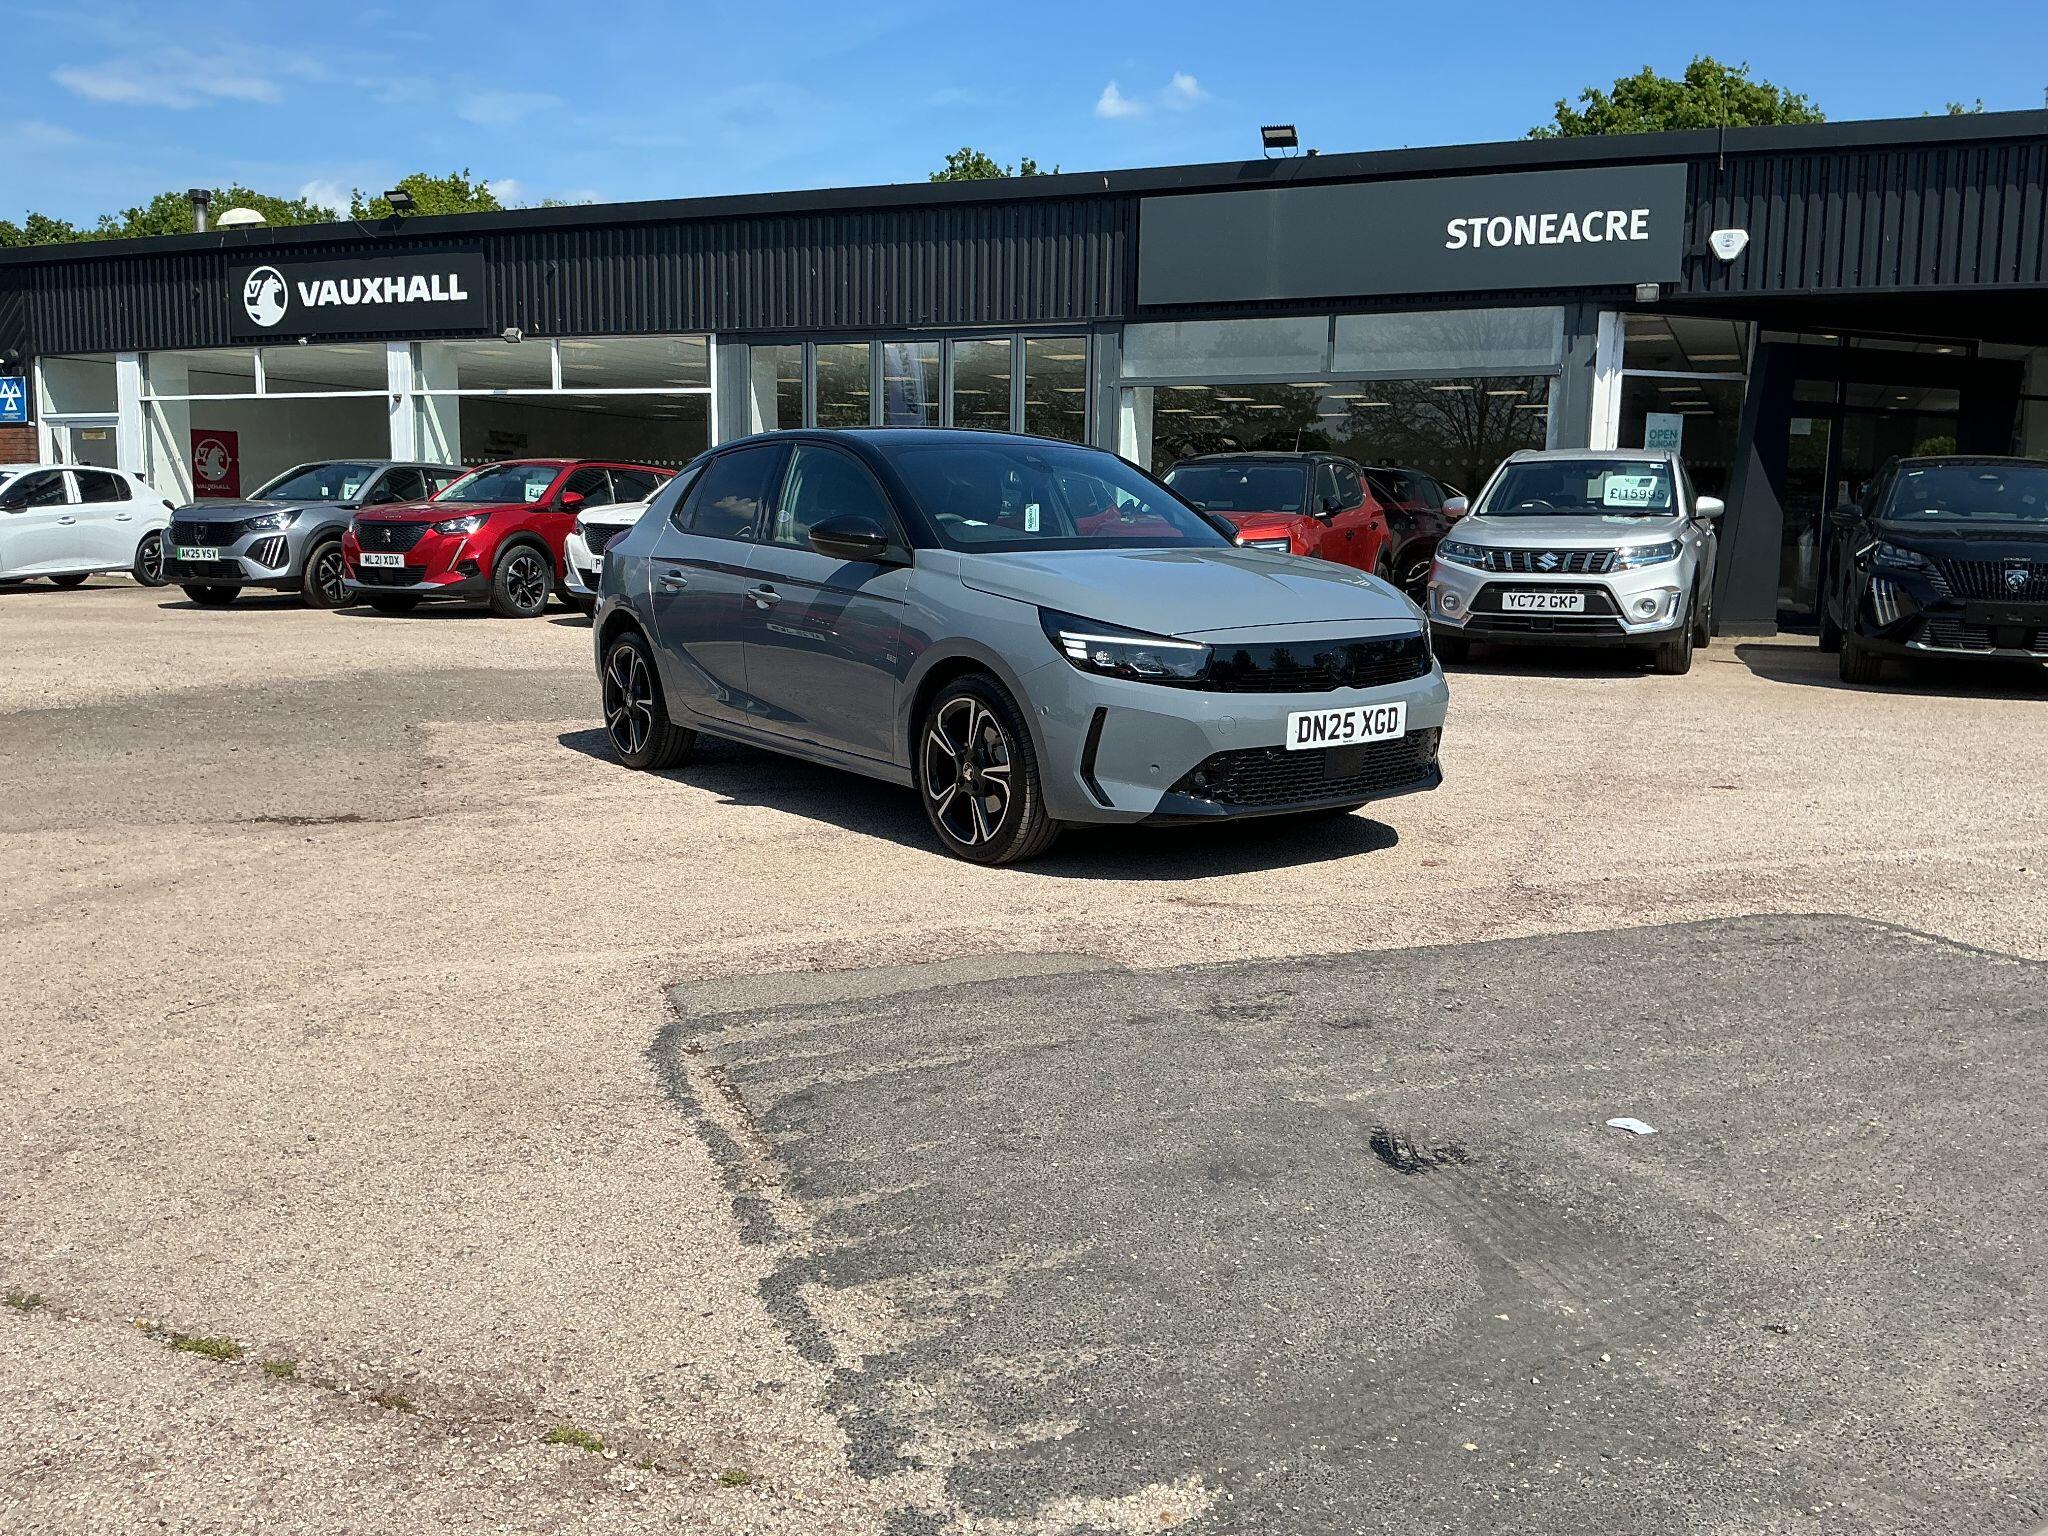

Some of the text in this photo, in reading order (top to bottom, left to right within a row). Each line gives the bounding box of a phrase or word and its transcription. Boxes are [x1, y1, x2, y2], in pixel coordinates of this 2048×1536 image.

[1445, 209, 1650, 250] STONEACRE
[297, 274, 468, 307] VAUXHALL
[1649, 429, 1678, 440] OPEN
[1648, 440, 1677, 448] SUNDAY
[383, 555, 400, 566] XDX
[1509, 594, 1578, 609] YC72 GKP
[1297, 706, 1399, 744] DN25 XGD
